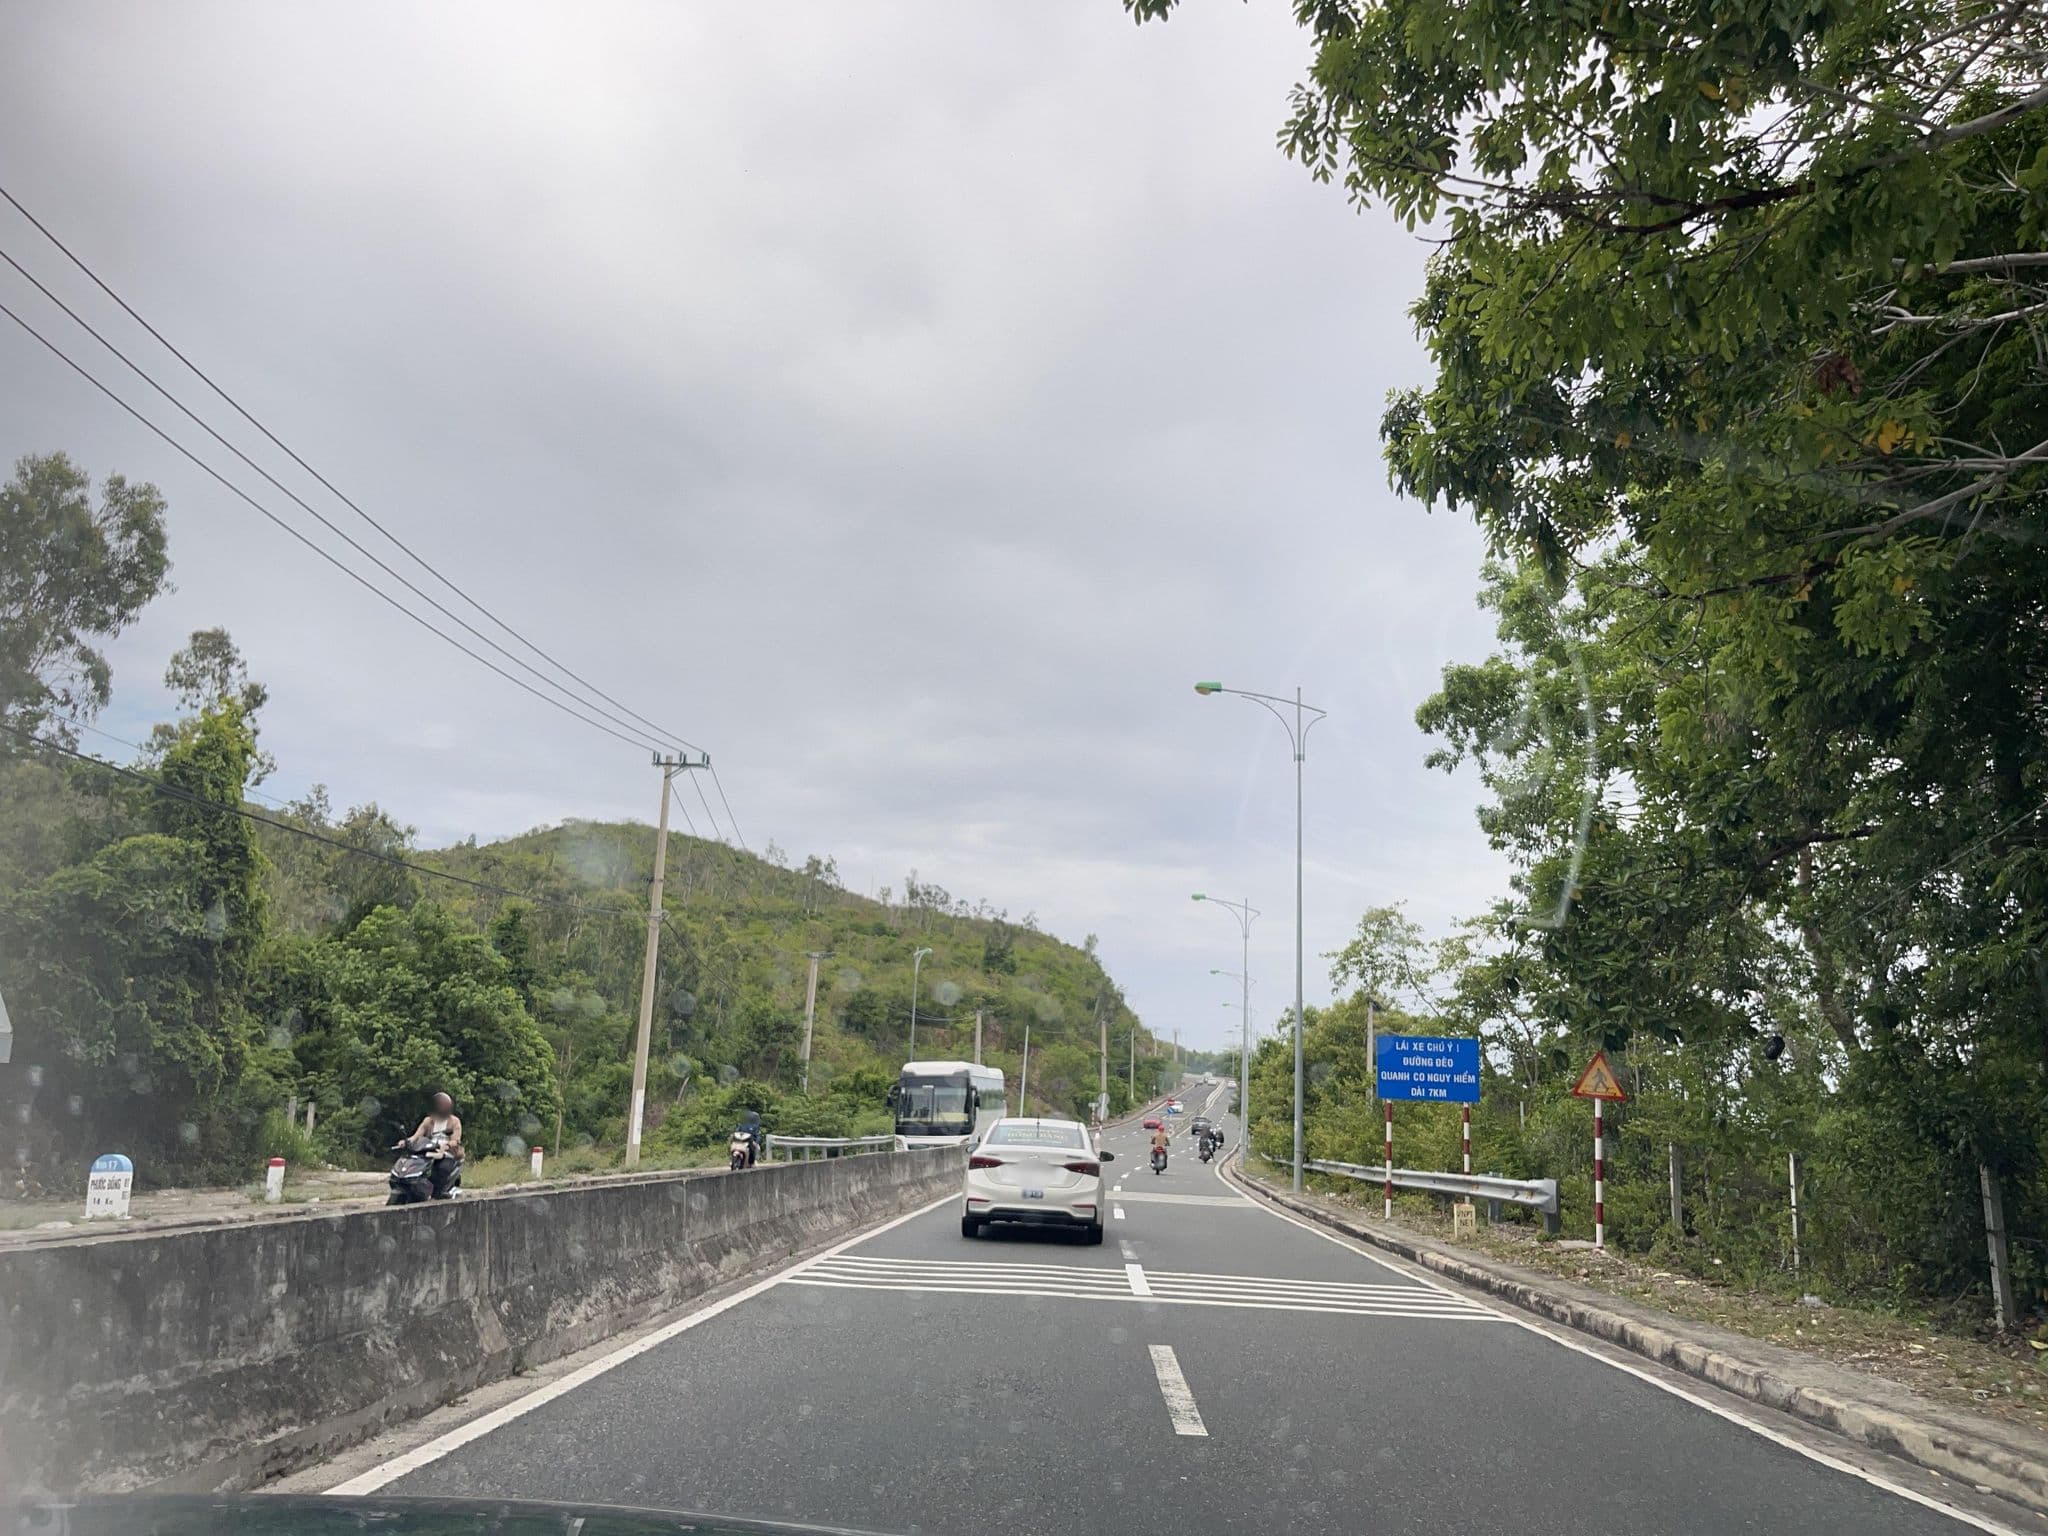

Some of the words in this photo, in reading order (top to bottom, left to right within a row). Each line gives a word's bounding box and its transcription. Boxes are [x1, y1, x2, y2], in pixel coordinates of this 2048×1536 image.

[1395, 1040, 1409, 1051] LÁI
[1412, 1042, 1424, 1051] XE
[1427, 1041, 1444, 1052] CHÚ
[1447, 1041, 1453, 1053] Ý
[1402, 1056, 1433, 1067] ĐƯỜNG
[1435, 1058, 1453, 1067] ĐÈO
[1381, 1071, 1410, 1081] QUANH
[1413, 1072, 1425, 1082] CO
[1427, 1073, 1451, 1083] NGUY
[1453, 1070, 1476, 1083] HIỂM
[1428, 1088, 1447, 1097] 7KM
